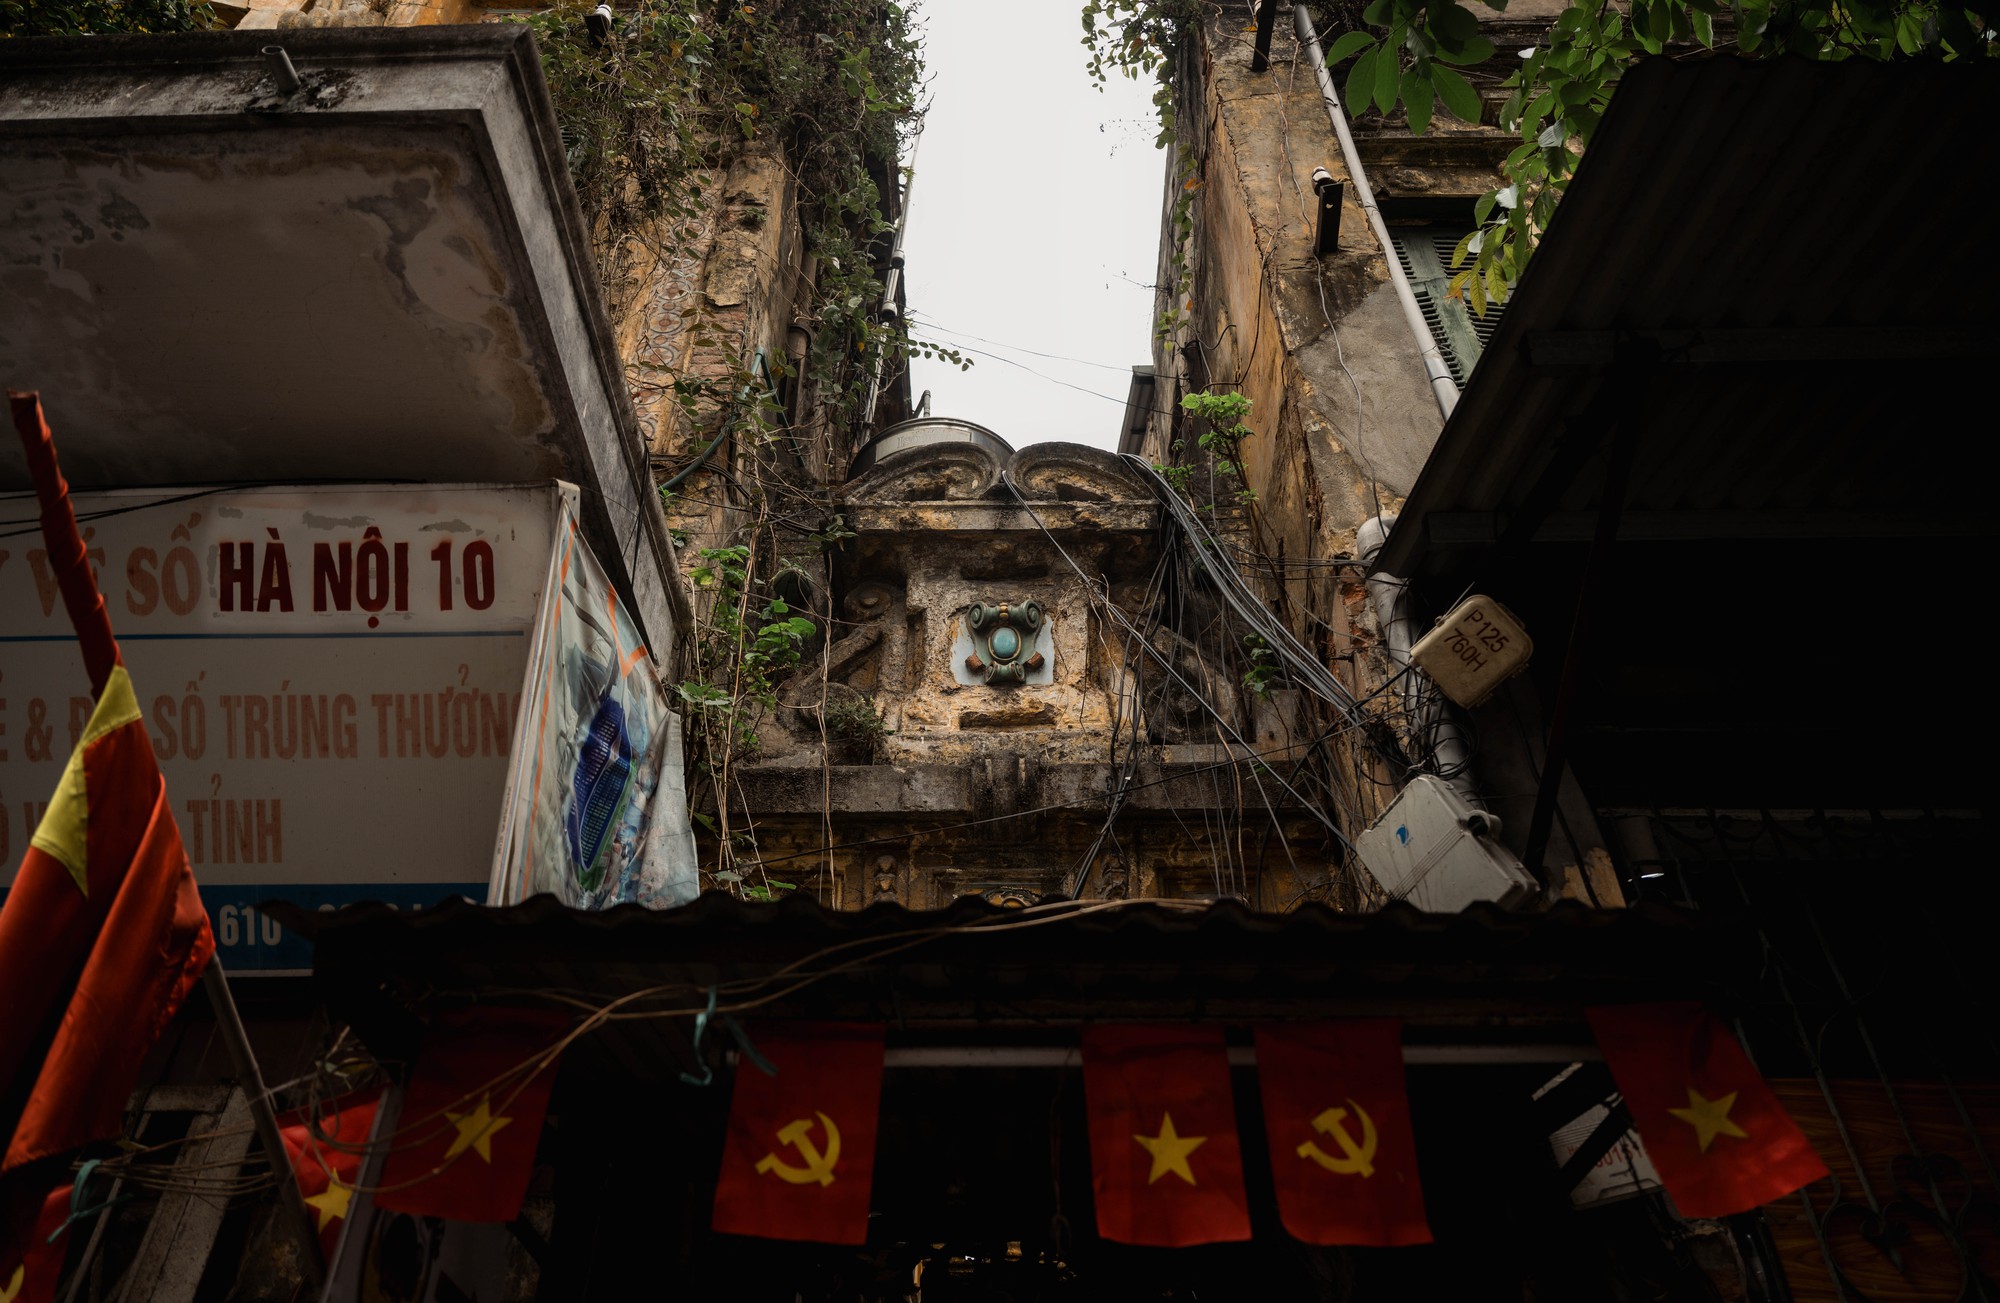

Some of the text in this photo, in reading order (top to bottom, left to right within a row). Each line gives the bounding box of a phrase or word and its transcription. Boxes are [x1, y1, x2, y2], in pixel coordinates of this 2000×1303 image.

[126, 512, 201, 616] SỐ
[219, 527, 294, 612] HÀ
[313, 526, 409, 628] NỘI
[431, 540, 495, 611] 10
[1444, 627, 1488, 672] 760H
[1464, 609, 1510, 653] P125
[24, 697, 53, 762] &
[153, 670, 206, 760] SỐ
[220, 680, 357, 760] TRÚNG
[371, 663, 522, 758] THƯỞN
[187, 773, 282, 864] TỈNH
